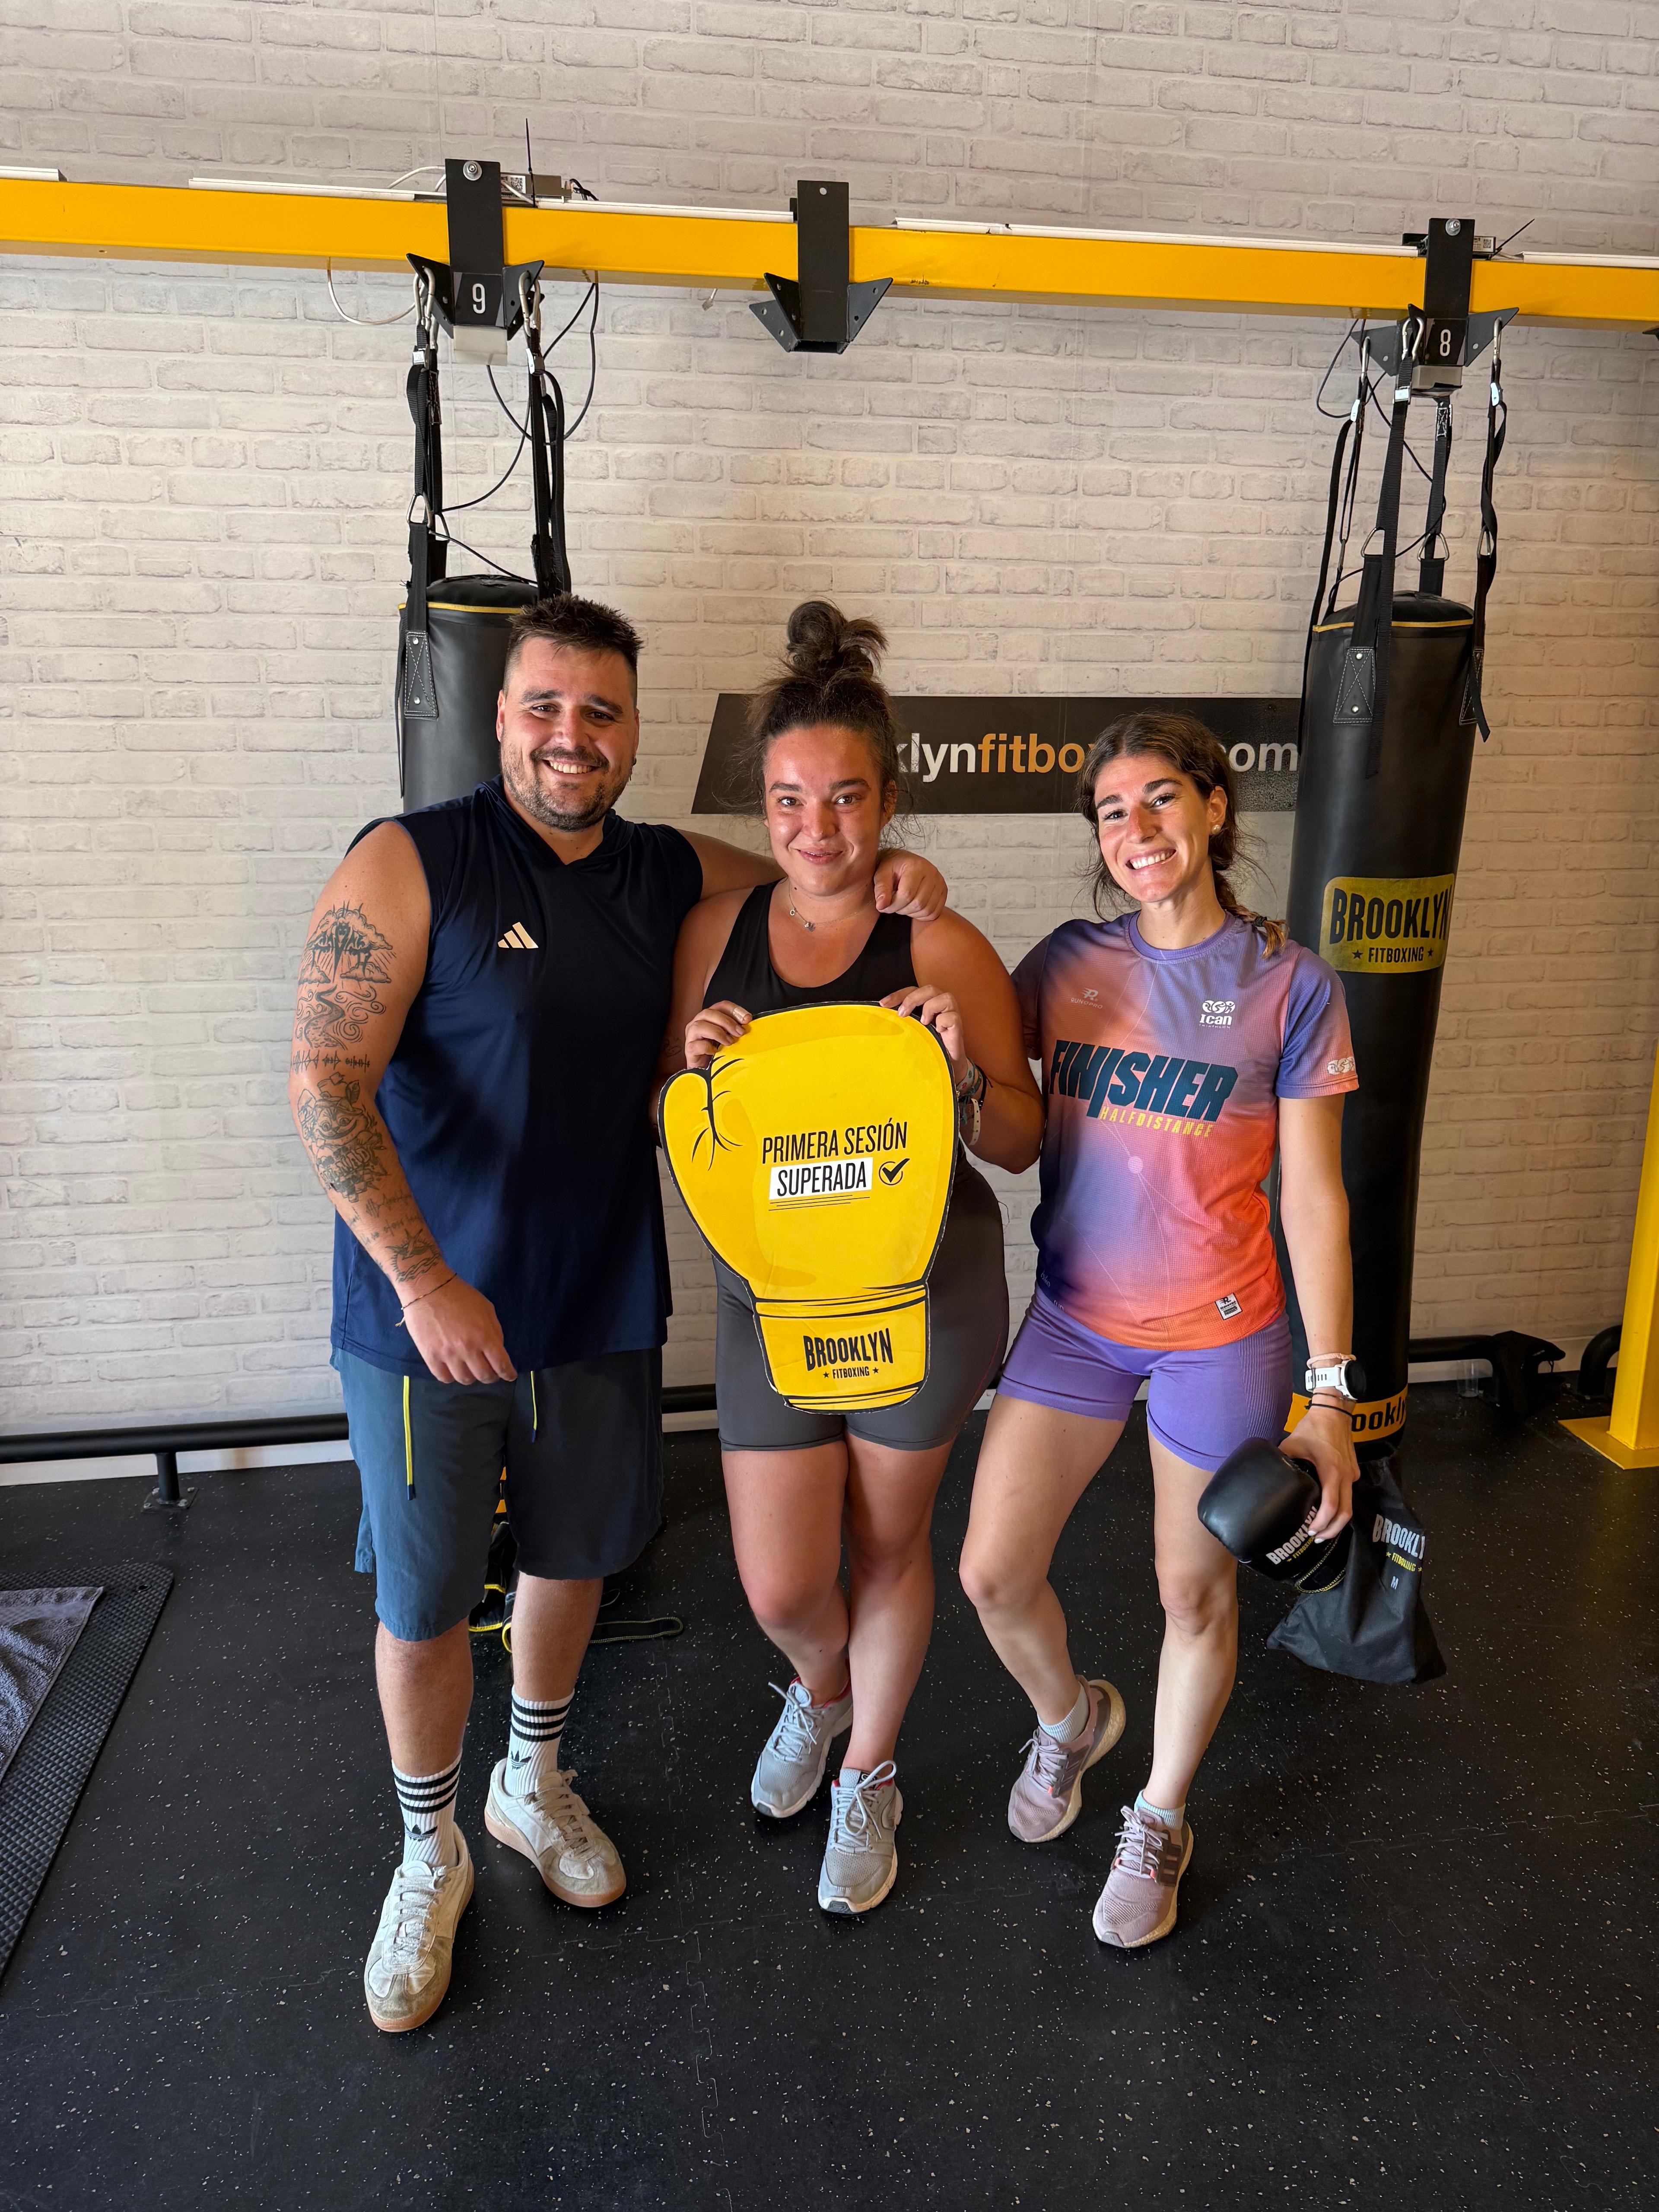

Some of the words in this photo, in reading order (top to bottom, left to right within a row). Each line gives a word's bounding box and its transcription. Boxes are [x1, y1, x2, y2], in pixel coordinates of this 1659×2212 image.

[472, 283, 486, 314] 9
[1440, 329, 1451, 357] 8
[1329, 884, 1452, 945] BROOKLYN
[1368, 946, 1424, 963] FITBOXING
[1199, 1014, 1232, 1026] Ican
[1049, 1039, 1239, 1122] FINISHER
[1099, 1106, 1214, 1138] HALFDISTANCE
[762, 1129, 839, 1164] PRIMERA
[844, 1117, 907, 1155] SESIÓN
[777, 1161, 866, 1196] SUPERADA
[803, 1328, 893, 1371] BROOKLYN
[832, 1366, 870, 1379] FITBOXING
[1392, 1552, 1417, 1572] FITBOXING
[1390, 1576, 1399, 1590] M
